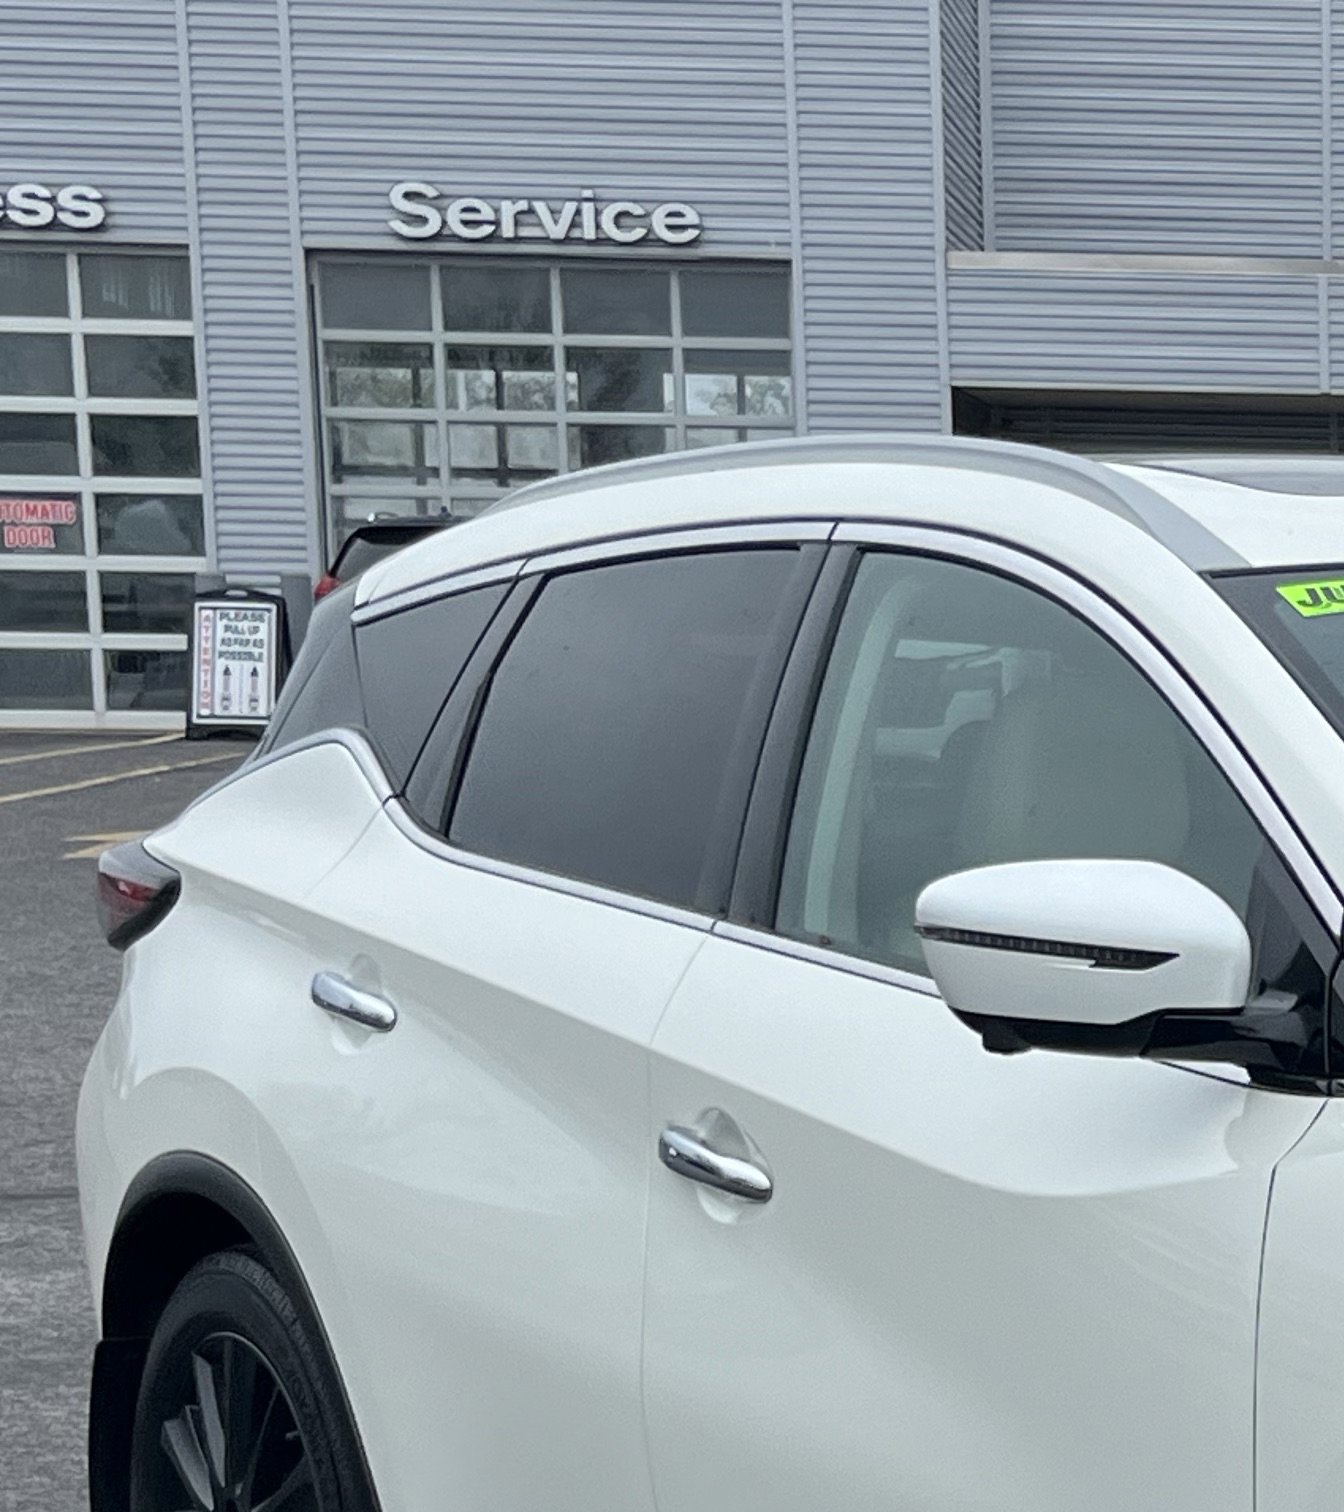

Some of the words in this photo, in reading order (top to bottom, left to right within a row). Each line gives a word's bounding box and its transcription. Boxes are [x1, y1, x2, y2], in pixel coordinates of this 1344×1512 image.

[0, 183, 105, 229] ss
[388, 182, 702, 245] Service
[0, 501, 76, 523] TOMATIC
[5, 526, 54, 548] DOOR
[219, 611, 265, 623] PLEASE
[224, 624, 246, 635] PULL
[247, 625, 260, 636] UP
[218, 650, 264, 663] POSSIBLE
